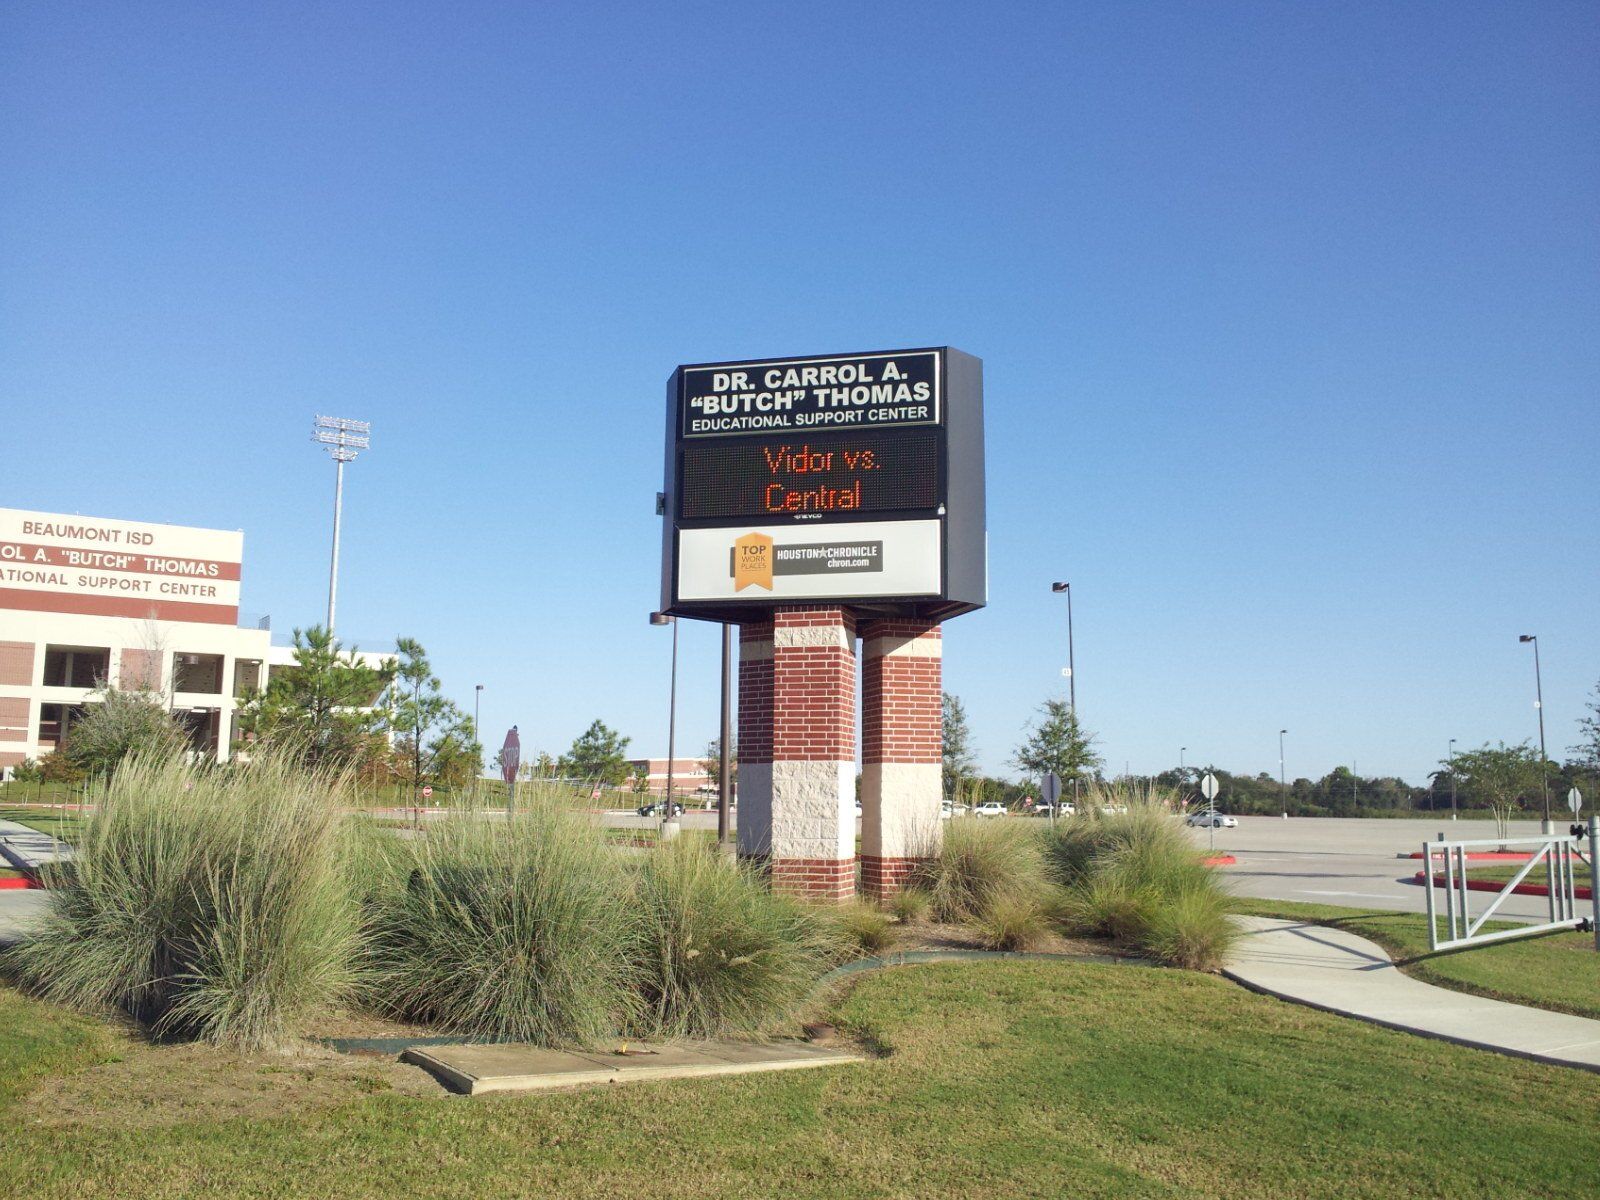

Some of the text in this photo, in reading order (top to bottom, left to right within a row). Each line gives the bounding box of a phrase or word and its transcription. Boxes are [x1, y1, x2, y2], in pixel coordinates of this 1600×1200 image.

[713, 361, 908, 392] DR. CARROL A.
[813, 381, 930, 407] THOMAS
[692, 406, 928, 431] EDUCATIONAL SUPPORT CENTER
[764, 445, 881, 474] Vidor vs.
[766, 480, 860, 511] Central
[22, 521, 154, 546] BEAUMONT ISD
[33, 548, 51, 563] A.
[61, 550, 136, 569] "BUTCH"
[144, 557, 219, 577] THOMAS
[741, 545, 766, 555] TOP
[741, 555, 766, 563] WORK
[777, 546, 878, 560] HOUSTON CHRONICLE
[827, 558, 870, 568] chron.com
[78, 575, 152, 592] SUPPORT
[159, 582, 217, 597] CENTER
